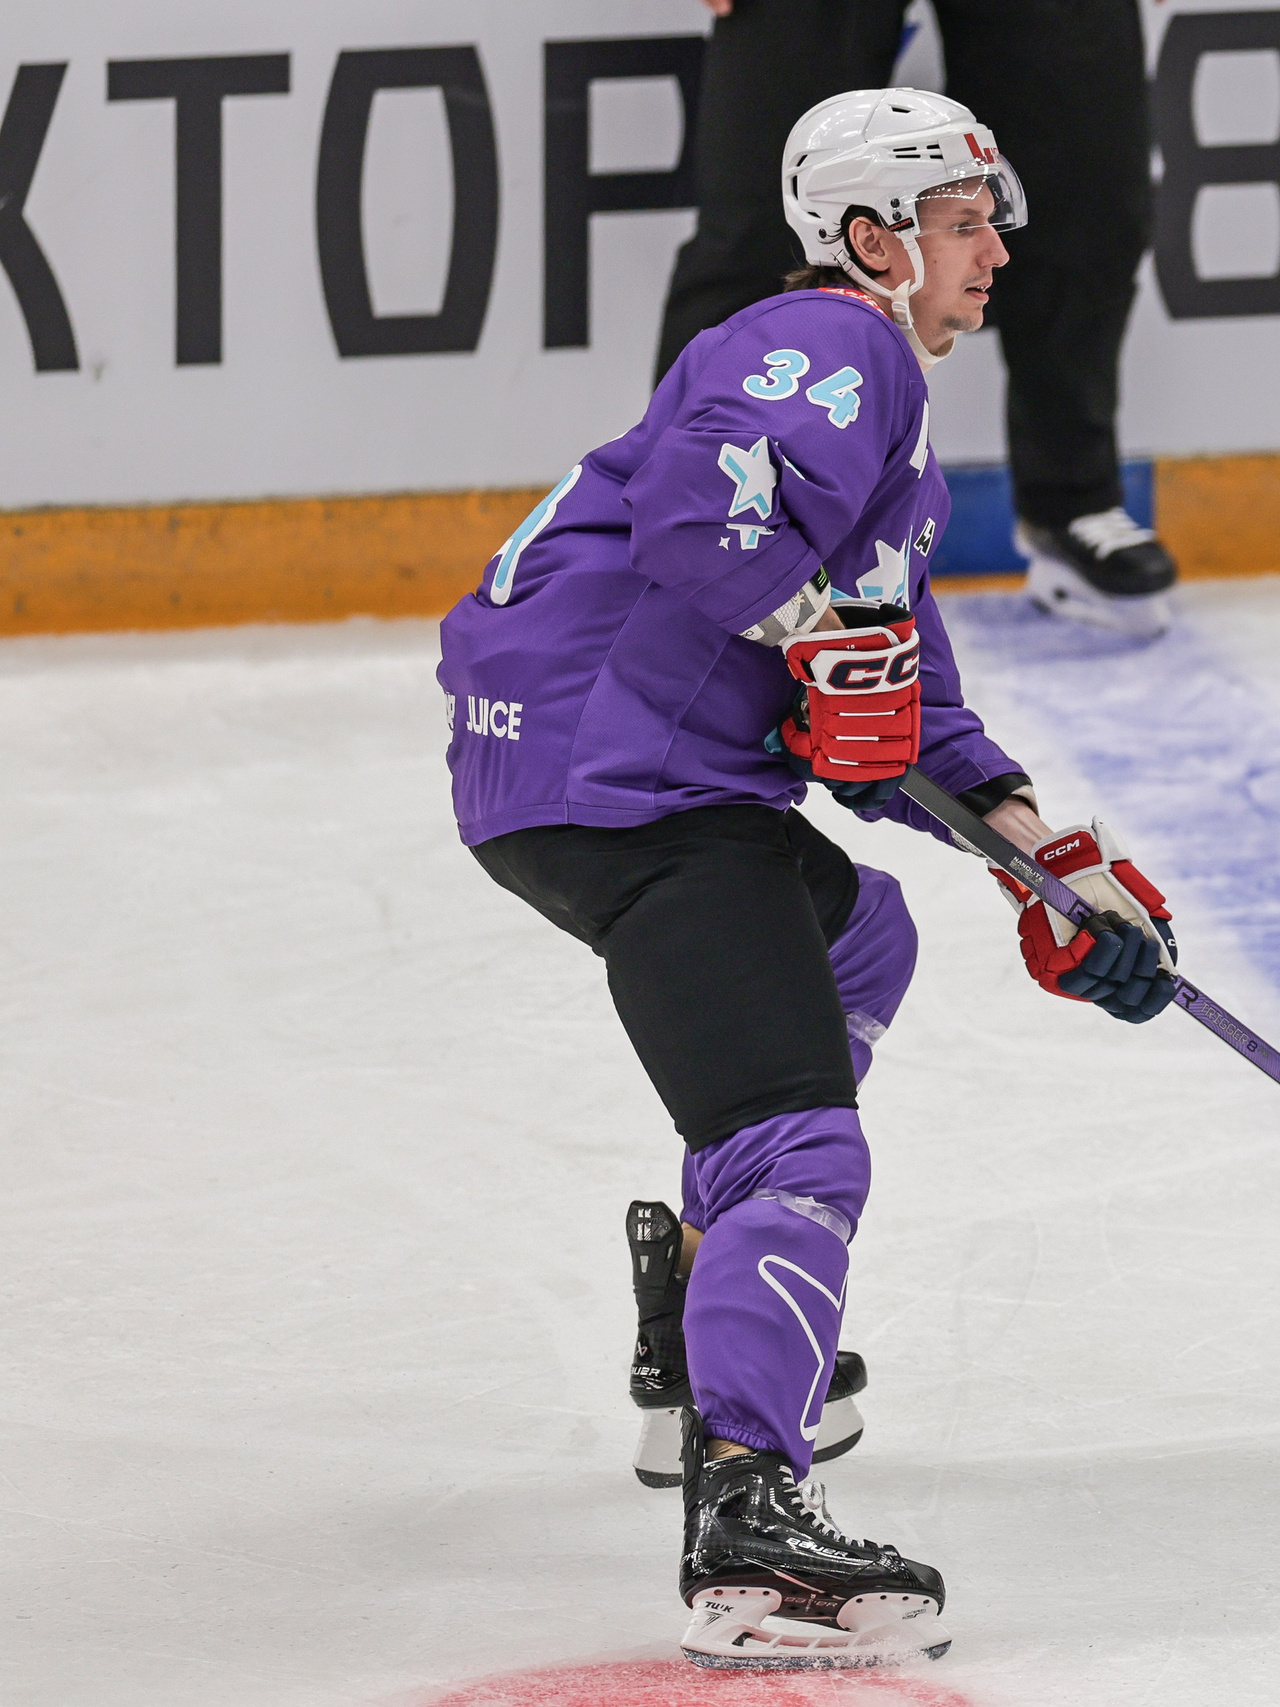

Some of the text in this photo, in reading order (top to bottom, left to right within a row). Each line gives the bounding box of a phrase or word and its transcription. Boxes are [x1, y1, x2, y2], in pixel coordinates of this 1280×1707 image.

[743, 348, 864, 430] 34
[466, 695, 523, 740] JUICE
[1043, 838, 1080, 861] CCM
[1013, 856, 1045, 882] NANOLITE
[1200, 1001, 1249, 1046] TRIGGER
[785, 1537, 849, 1558] BAUER
